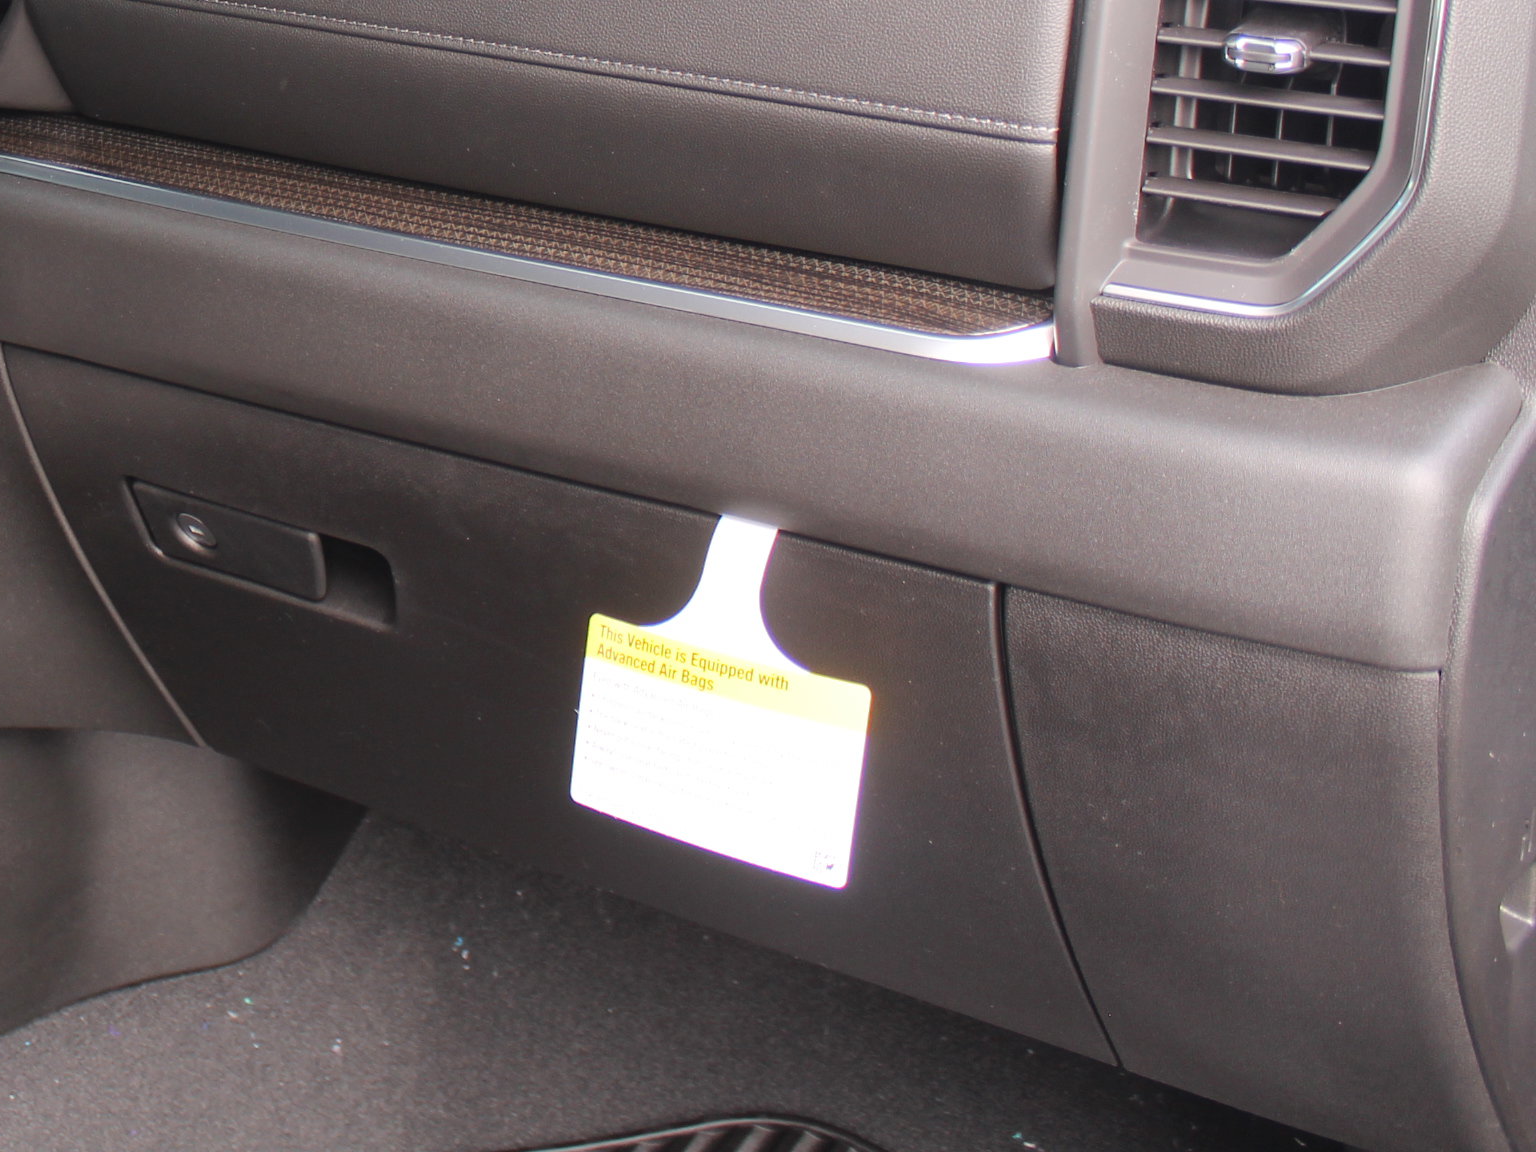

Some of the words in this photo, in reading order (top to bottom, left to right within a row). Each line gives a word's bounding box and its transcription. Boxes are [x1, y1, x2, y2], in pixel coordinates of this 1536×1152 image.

[596, 643, 655, 673] Advanced
[658, 660, 677, 680] Air
[681, 667, 715, 691] Bags
[599, 624, 624, 645] This
[627, 633, 672, 659] Vehicle
[675, 647, 687, 663] is
[691, 651, 754, 682] Equipped
[758, 671, 790, 691] with
